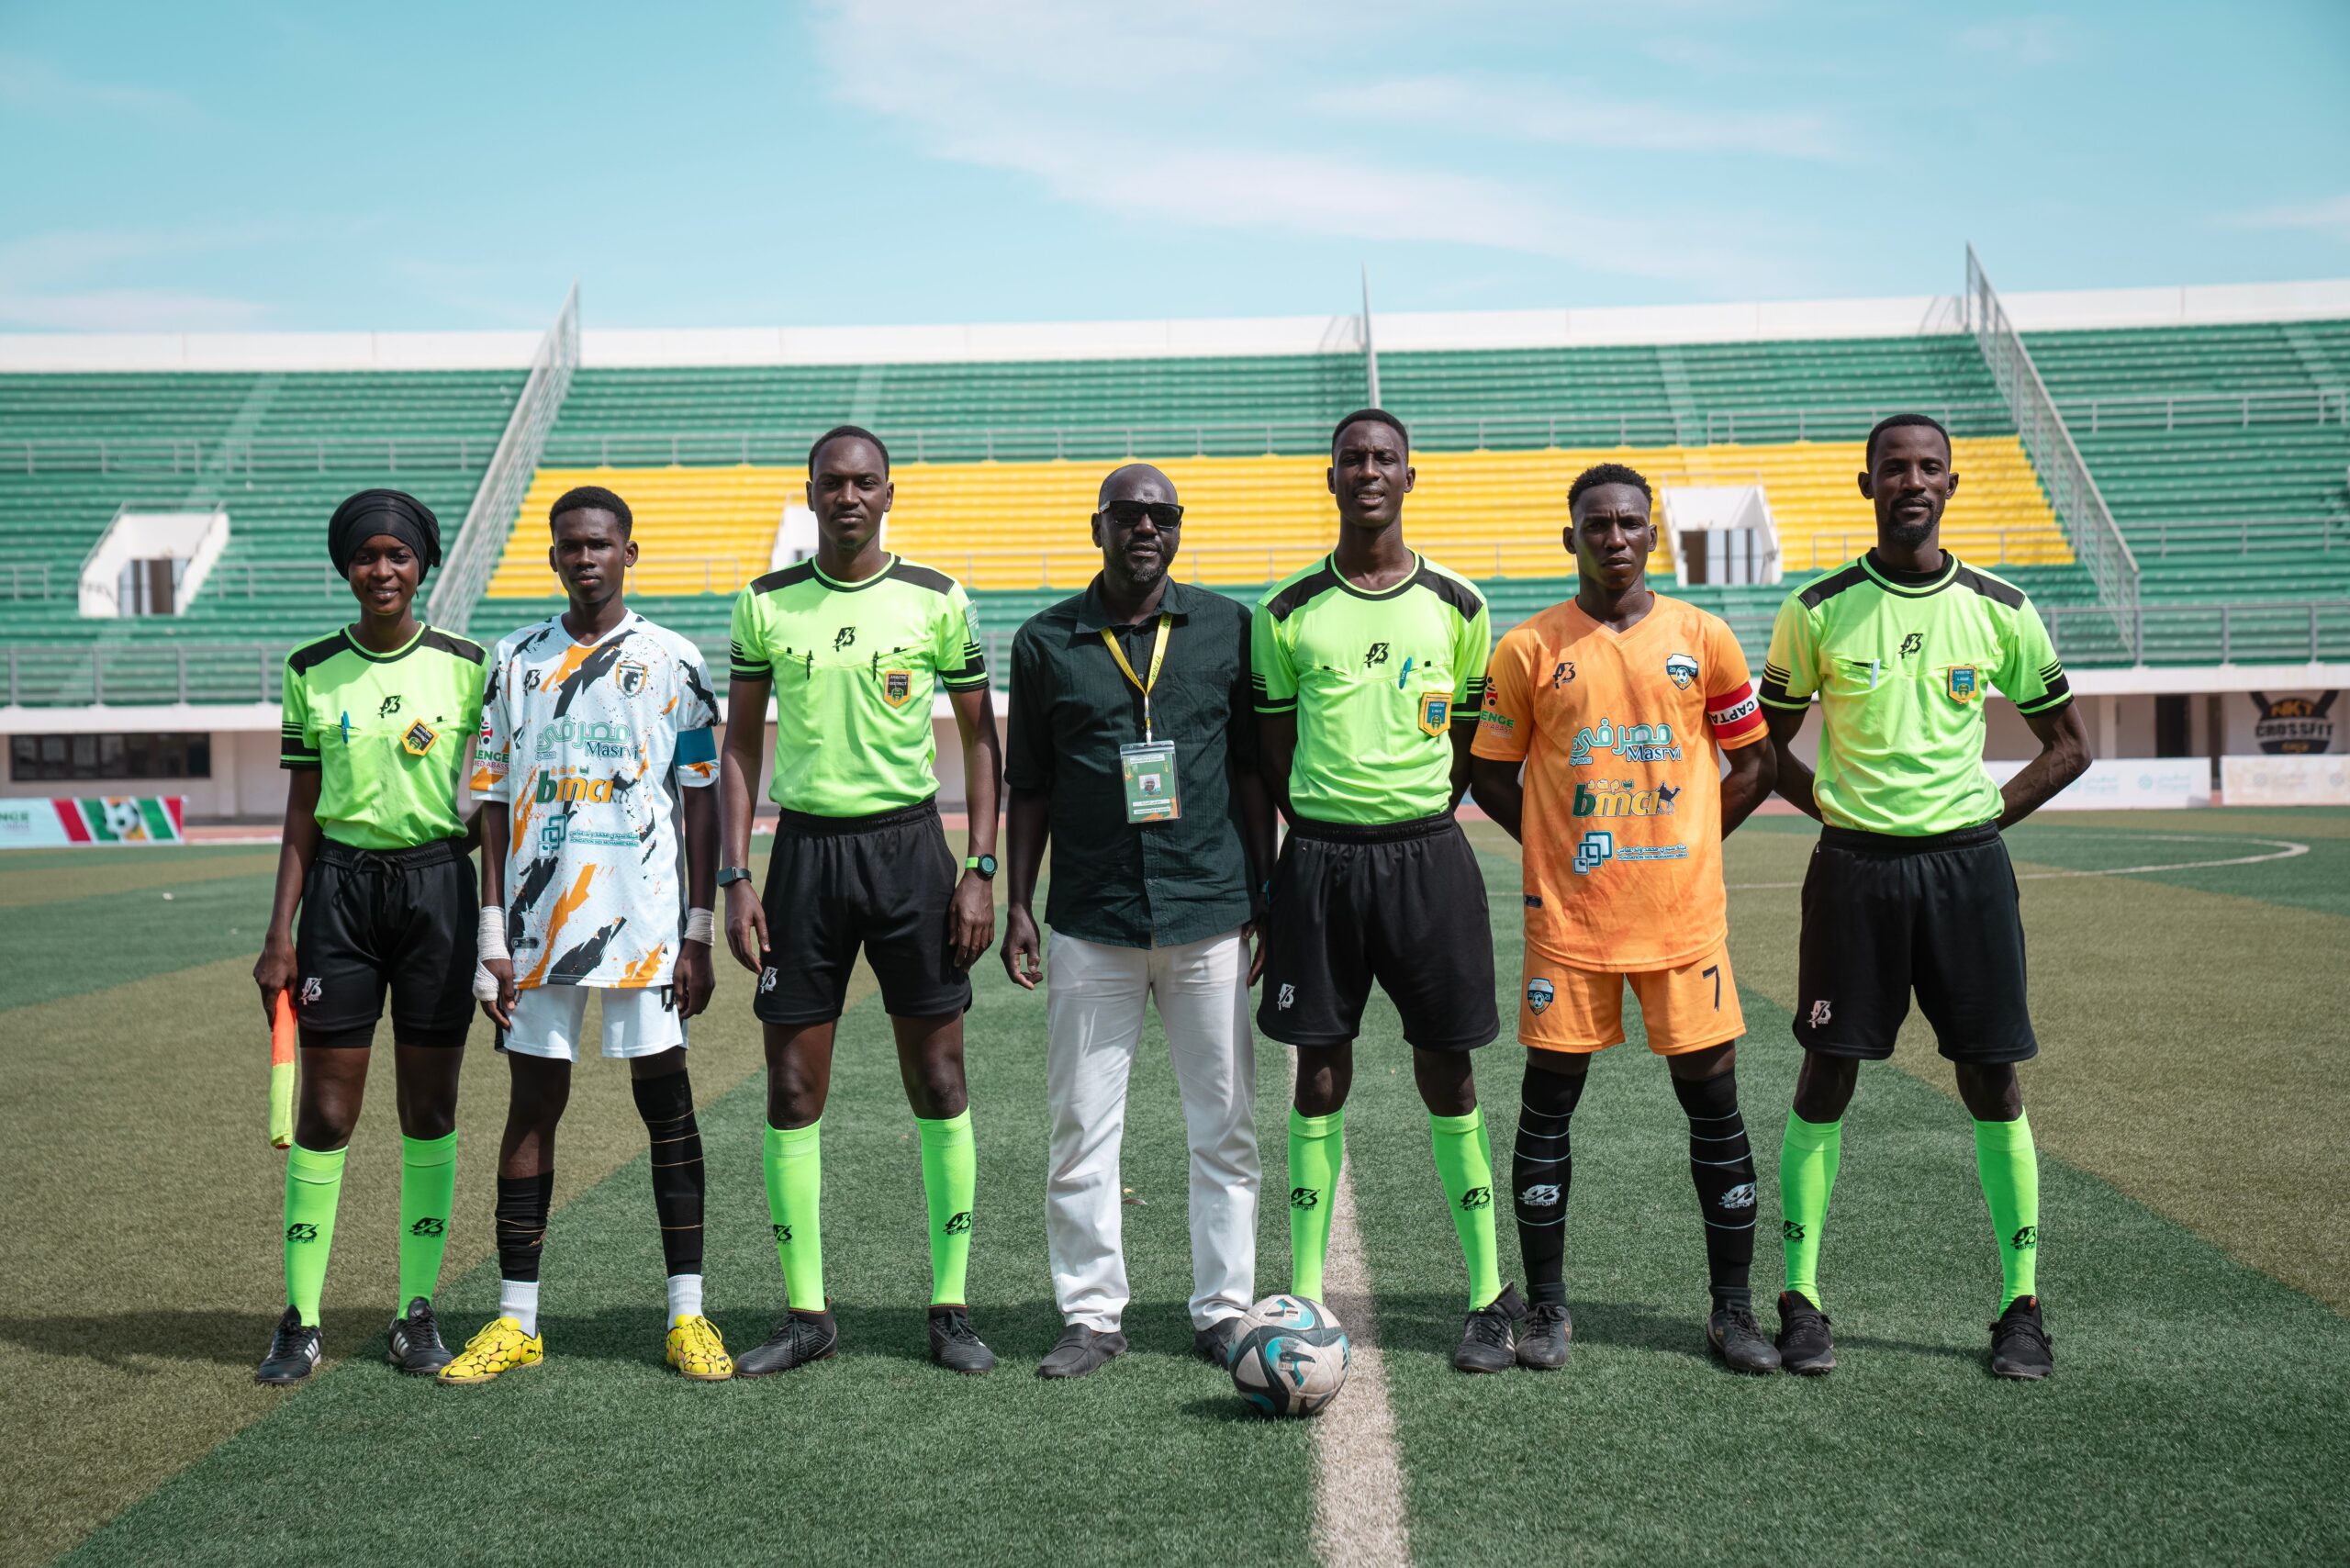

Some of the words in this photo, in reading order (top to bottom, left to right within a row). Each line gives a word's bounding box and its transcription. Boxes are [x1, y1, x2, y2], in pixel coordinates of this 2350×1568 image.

[585, 741, 640, 760] Masrvi
[1626, 744, 1683, 762] Masrvi
[1702, 964, 1721, 1012] 7
